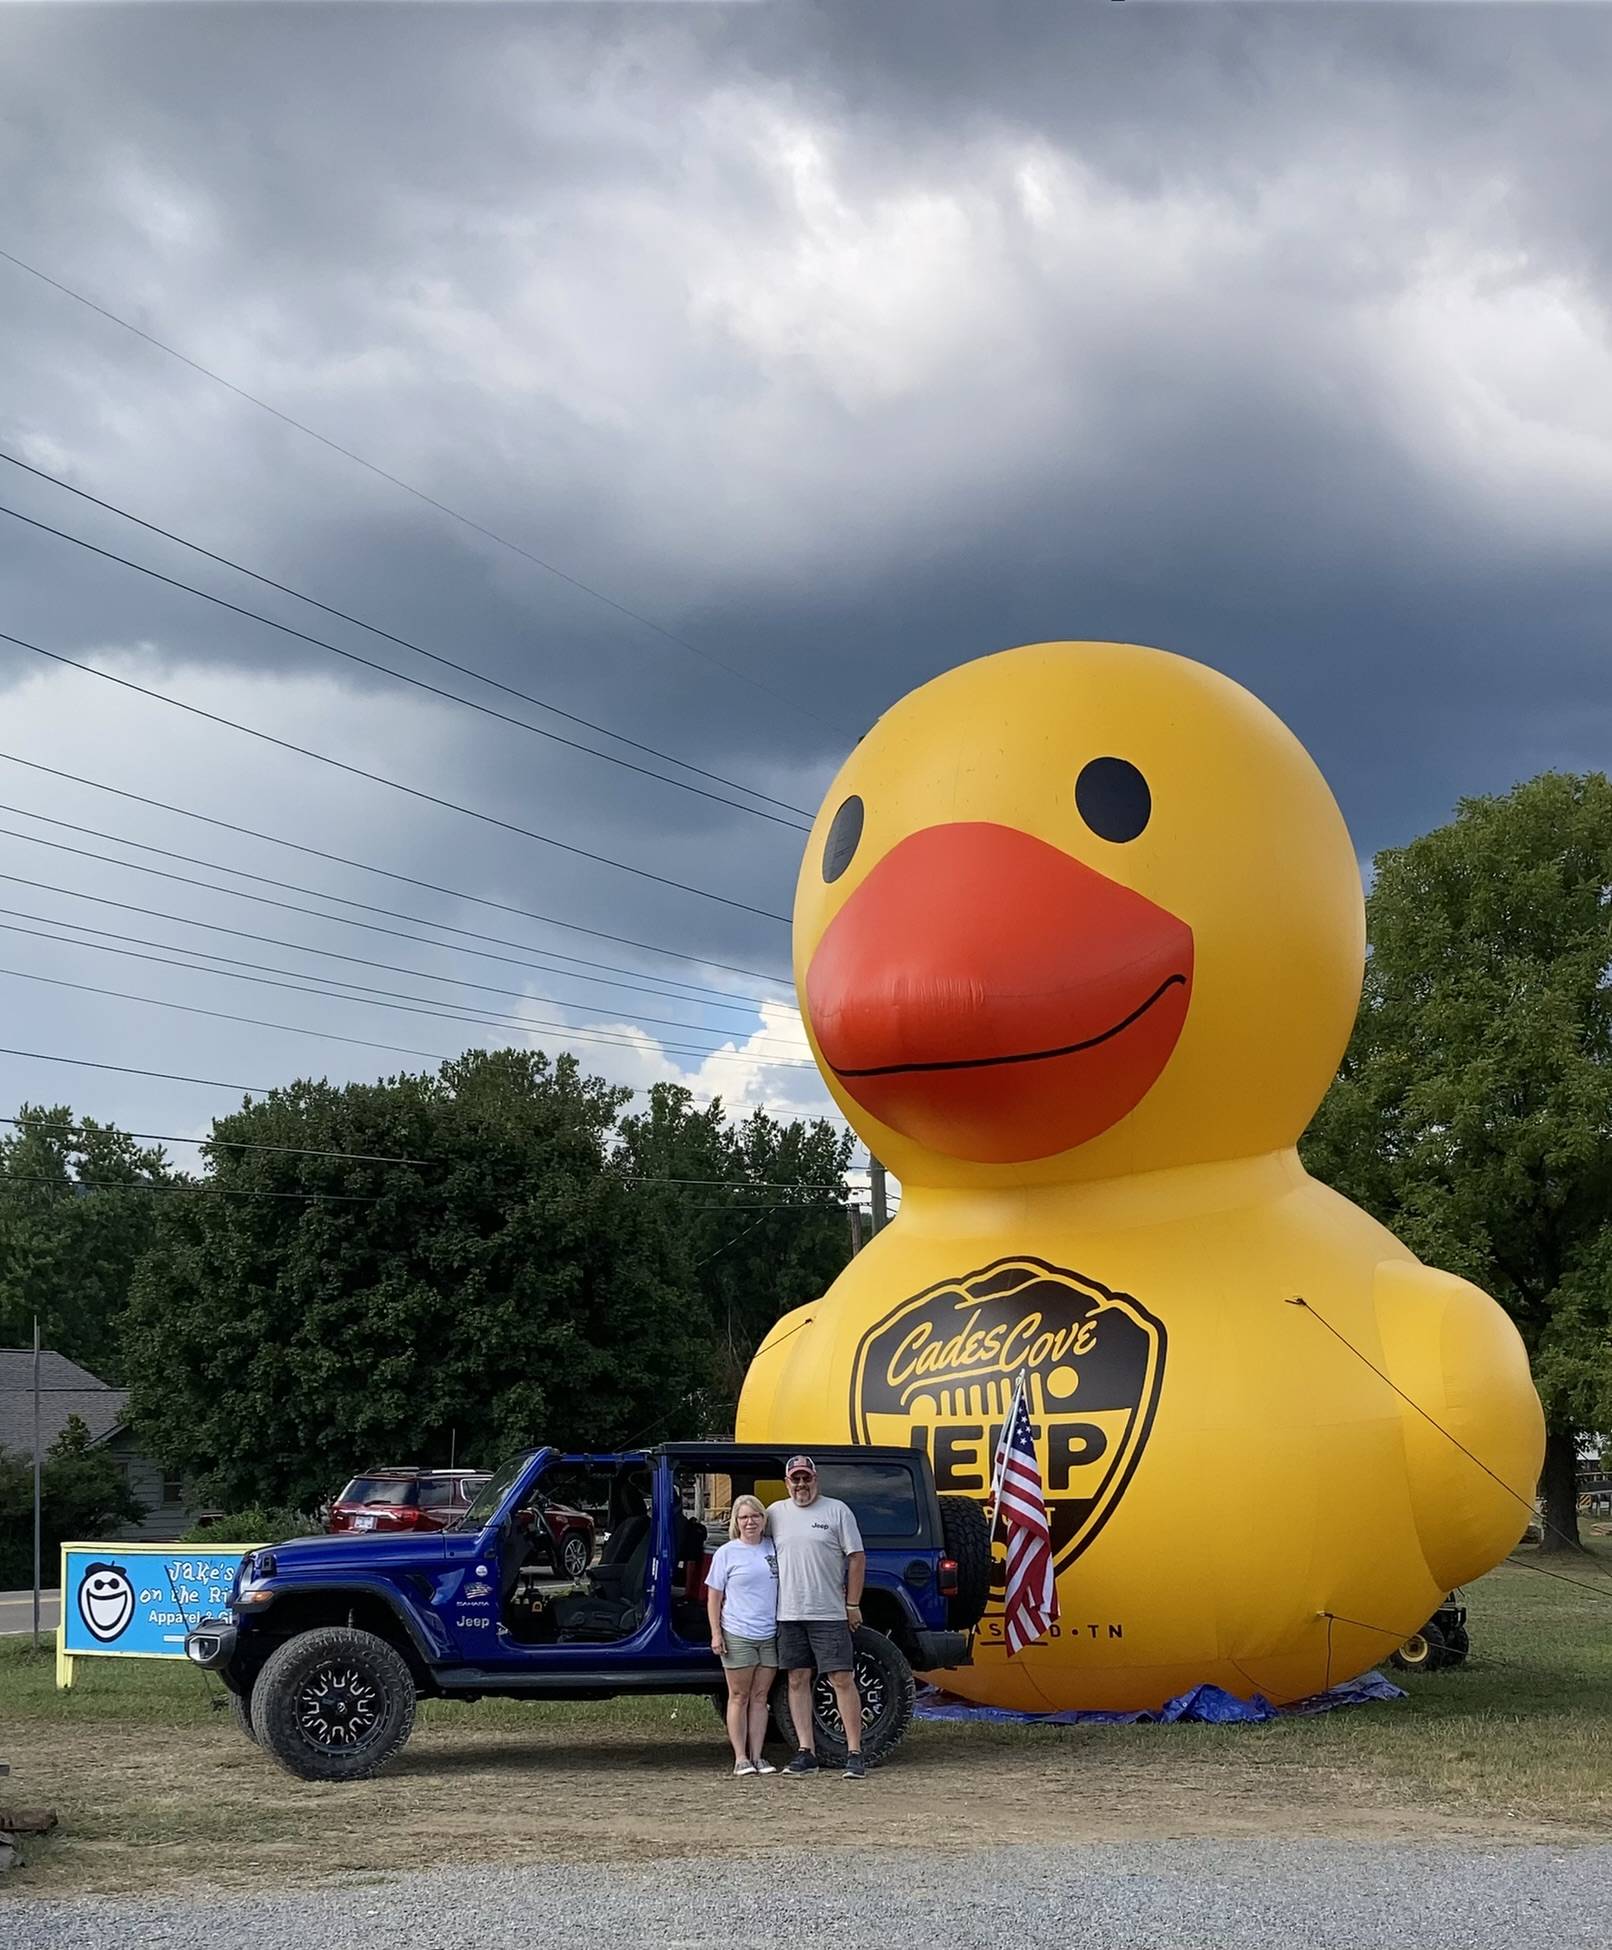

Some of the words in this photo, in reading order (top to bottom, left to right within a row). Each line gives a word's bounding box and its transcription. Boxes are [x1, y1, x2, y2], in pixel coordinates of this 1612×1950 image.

[812, 1522, 829, 1530] Jeep
[168, 1561, 234, 1585] Jake's
[140, 1588, 162, 1603] on
[171, 1585, 199, 1604] the
[208, 1585, 233, 1604] Ri
[148, 1610, 200, 1626] Apparel
[456, 1615, 490, 1628] Jeep
[1087, 1624, 1123, 1639] TN
